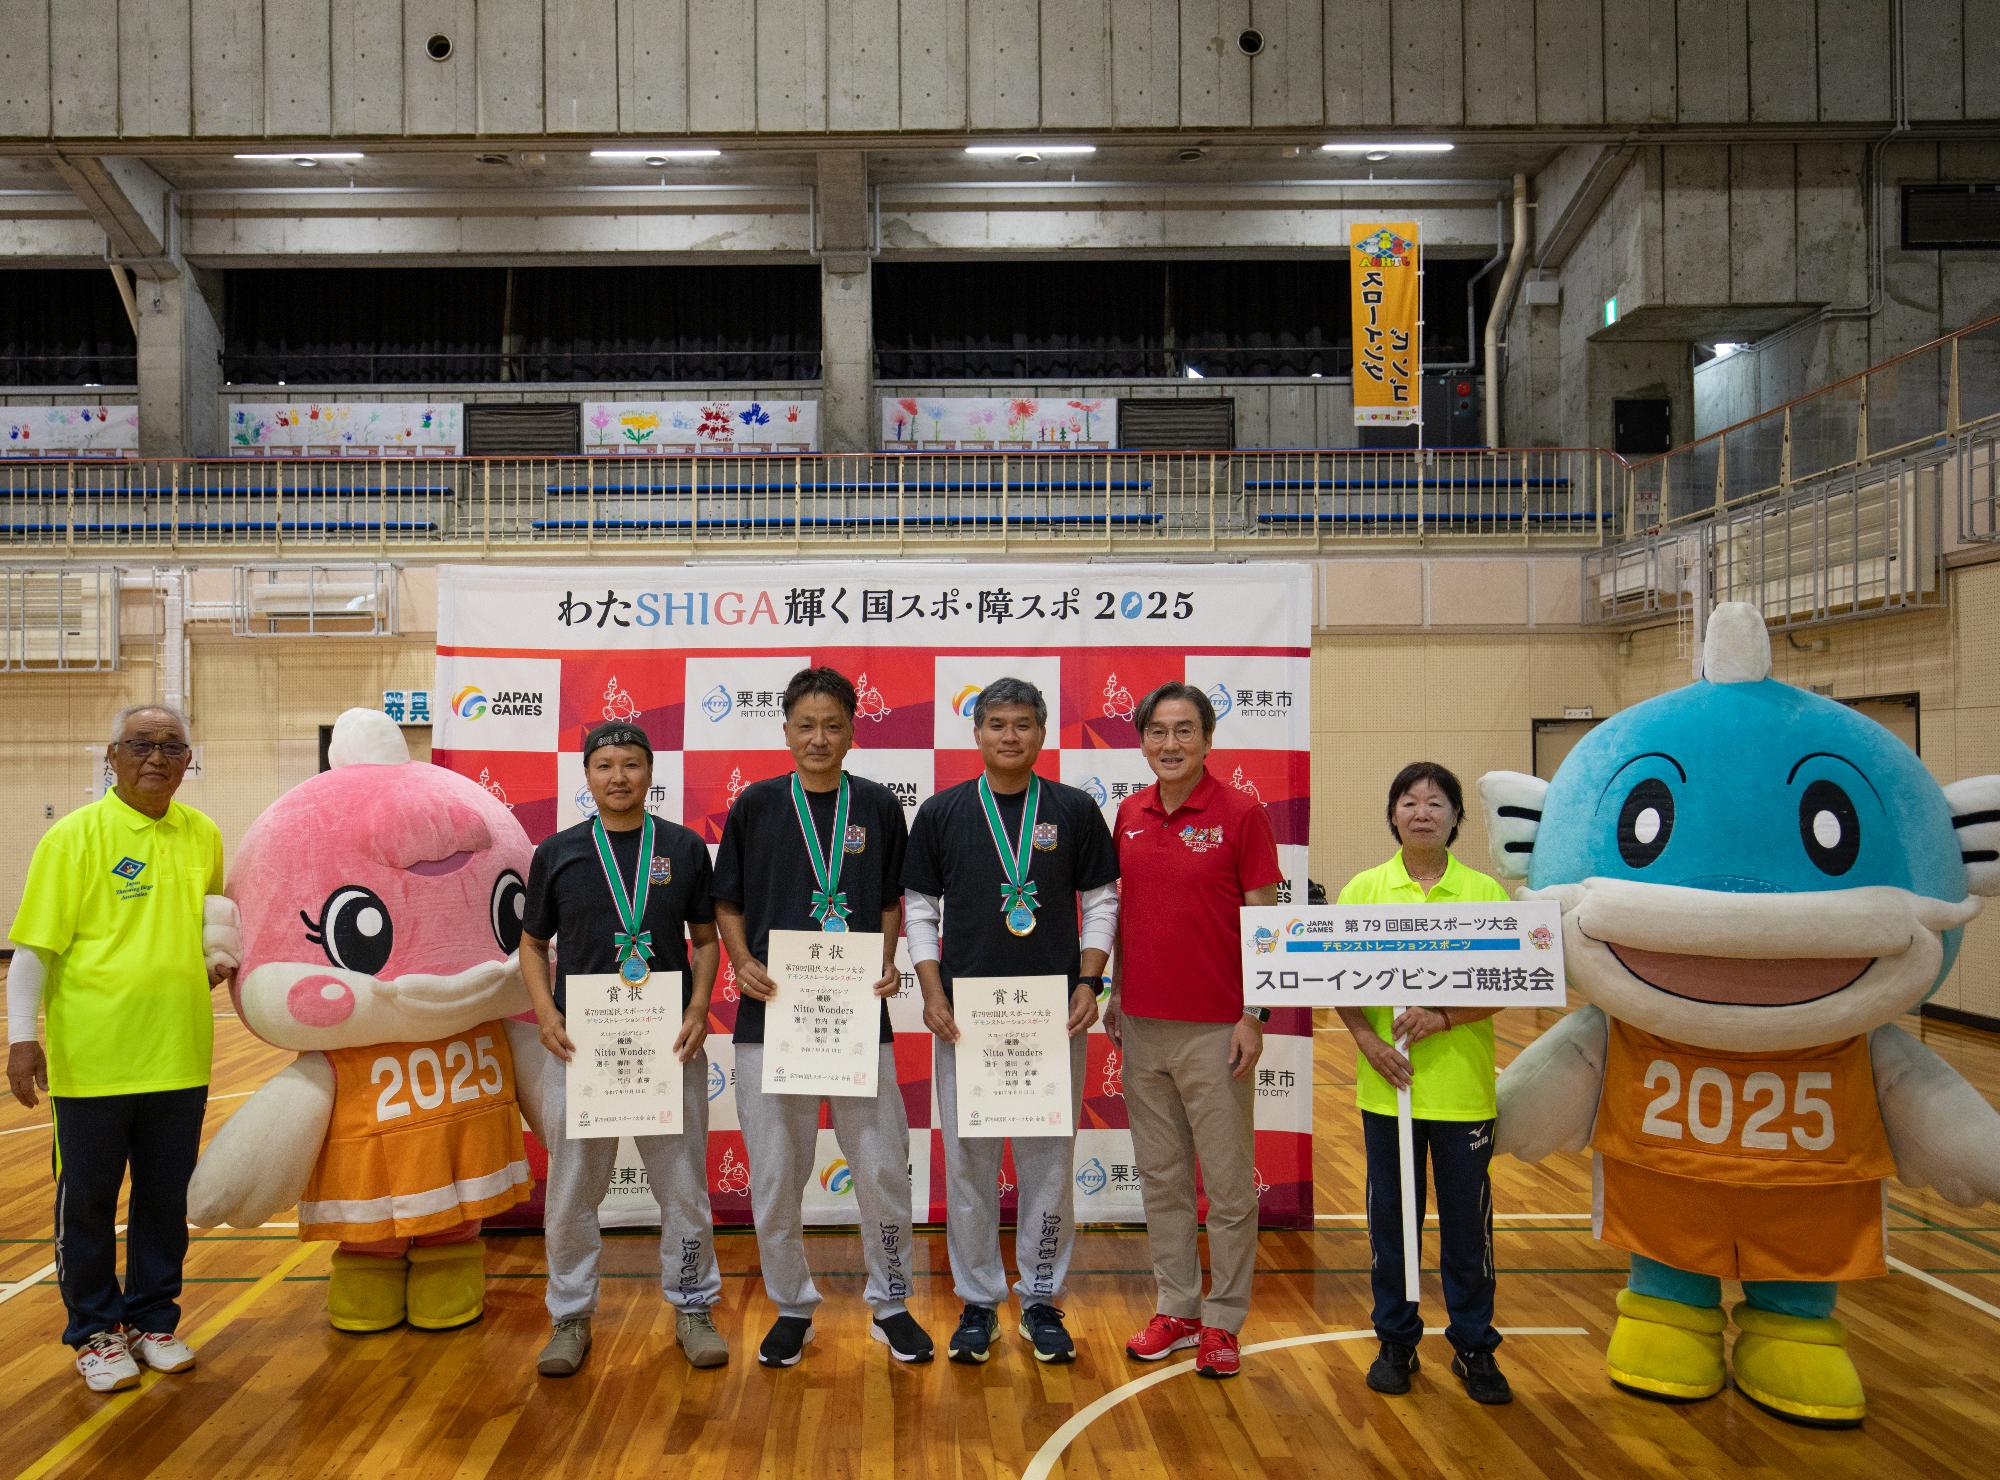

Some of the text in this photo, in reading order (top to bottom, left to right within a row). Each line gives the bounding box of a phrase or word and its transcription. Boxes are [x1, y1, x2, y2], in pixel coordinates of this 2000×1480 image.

[1094, 591, 1194, 619] 2025
[492, 692, 542, 703] JAPAN
[1236, 690, 1293, 707] 栗東市
[384, 691, 430, 722] 器具
[491, 704, 543, 716] GAMES
[809, 943, 844, 959] 賞状
[1322, 940, 1471, 951] デモンストレーションスポーツ
[1255, 966, 1554, 992] スローイングビンゴ競技会
[606, 986, 643, 1002] 賞状
[993, 989, 1029, 1005] 賞状
[793, 1004, 854, 1015] Nitto Wonders
[594, 1047, 656, 1057] Nitto Wonders
[983, 1048, 1043, 1057] Nitto Wonders
[371, 1036, 502, 1122] 2025
[1270, 1089, 1290, 1097] CITY
[1641, 1059, 1835, 1150] 2025
